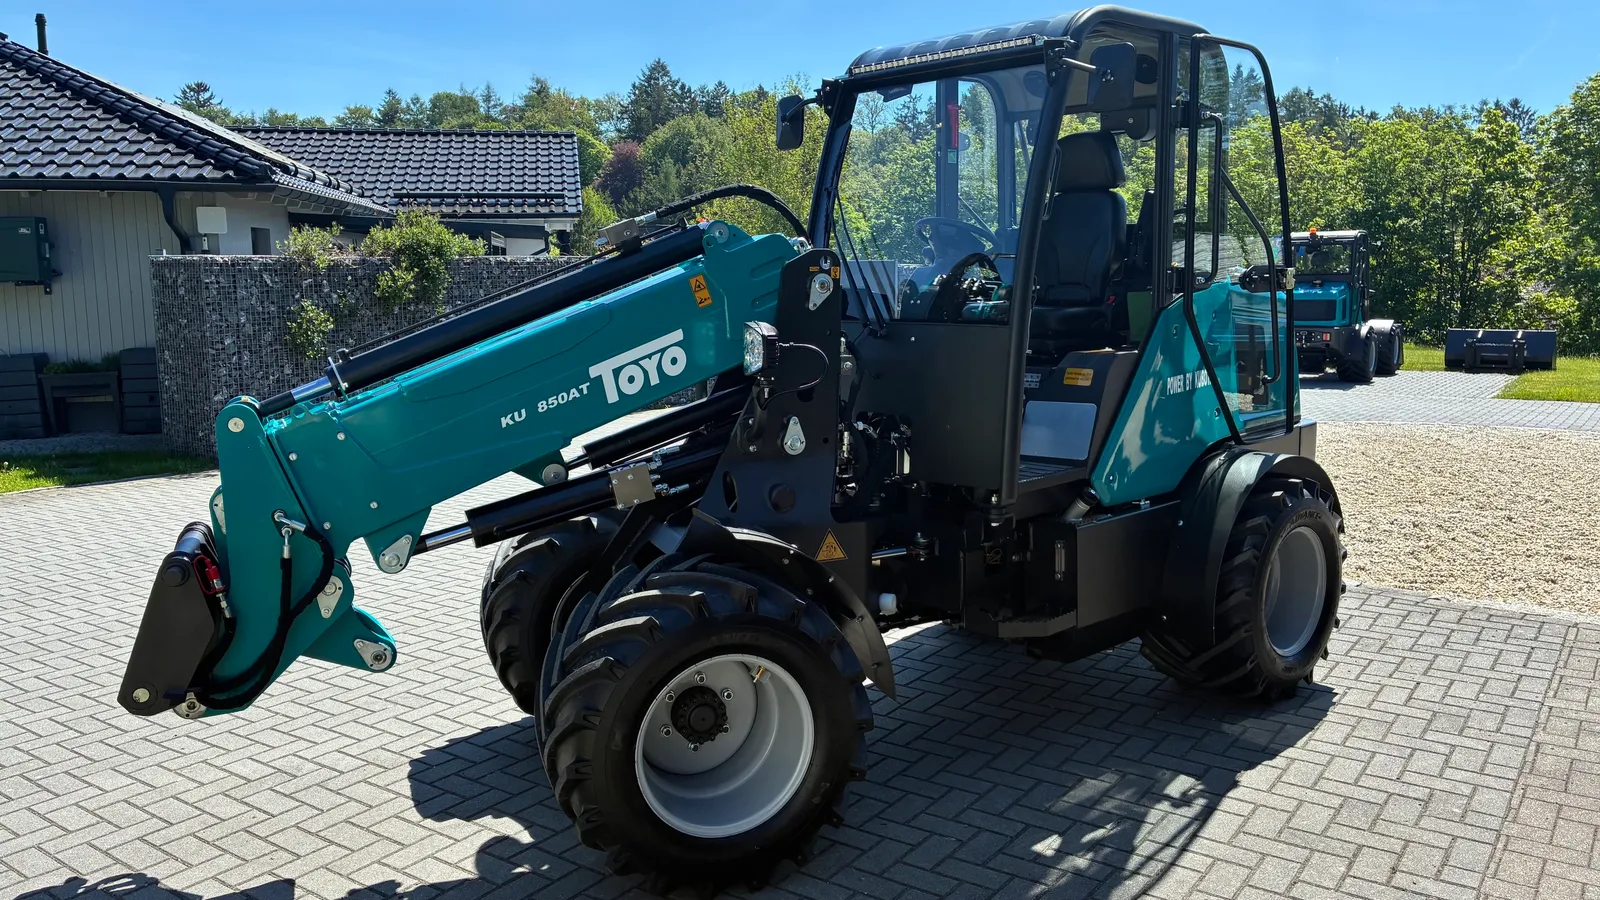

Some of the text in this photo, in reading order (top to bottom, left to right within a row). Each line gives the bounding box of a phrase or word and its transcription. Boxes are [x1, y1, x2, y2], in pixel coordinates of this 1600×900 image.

[589, 328, 687, 404] TOYO
[1167, 374, 1184, 395] POWER
[1186, 372, 1193, 391] BY
[500, 382, 590, 428] KU 850AT
